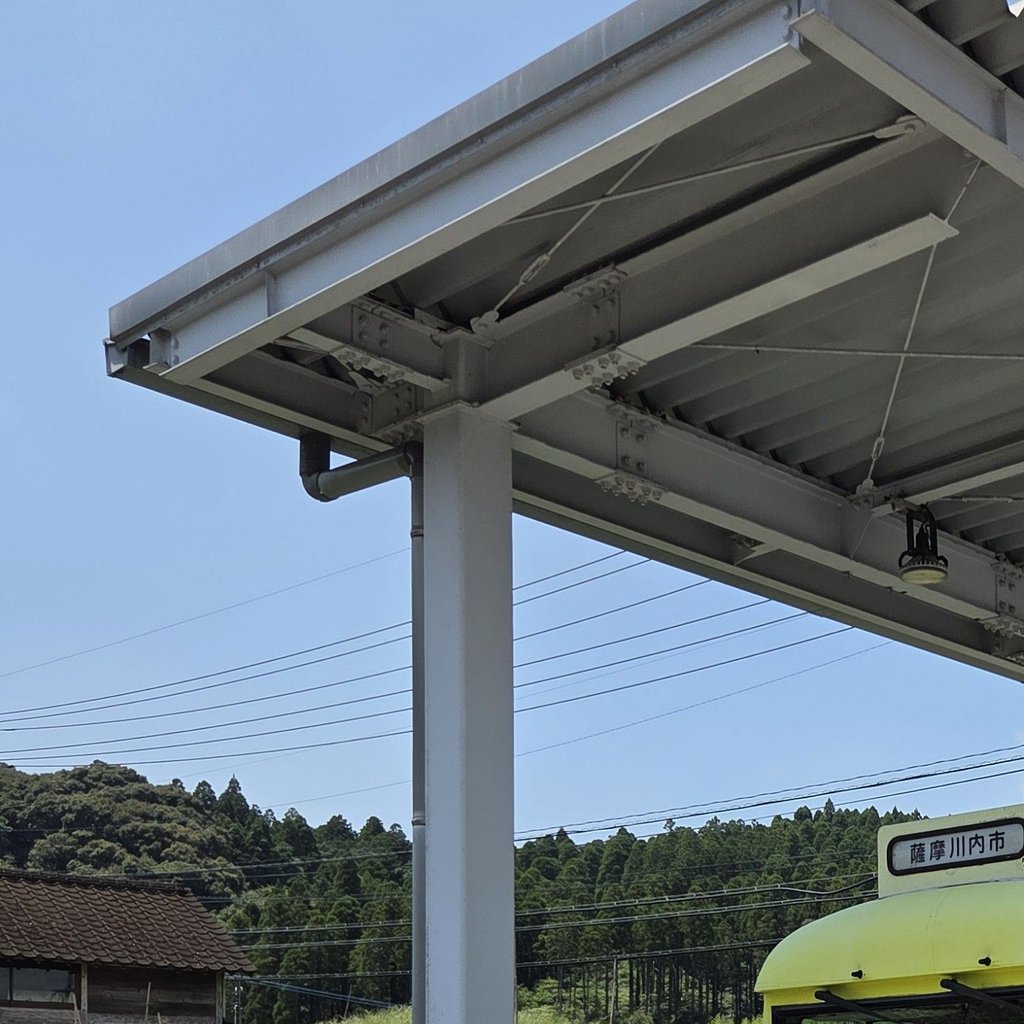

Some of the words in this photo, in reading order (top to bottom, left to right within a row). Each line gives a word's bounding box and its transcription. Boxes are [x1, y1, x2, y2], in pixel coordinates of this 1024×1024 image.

[910, 830, 1006, 864] 薩摩川内市
